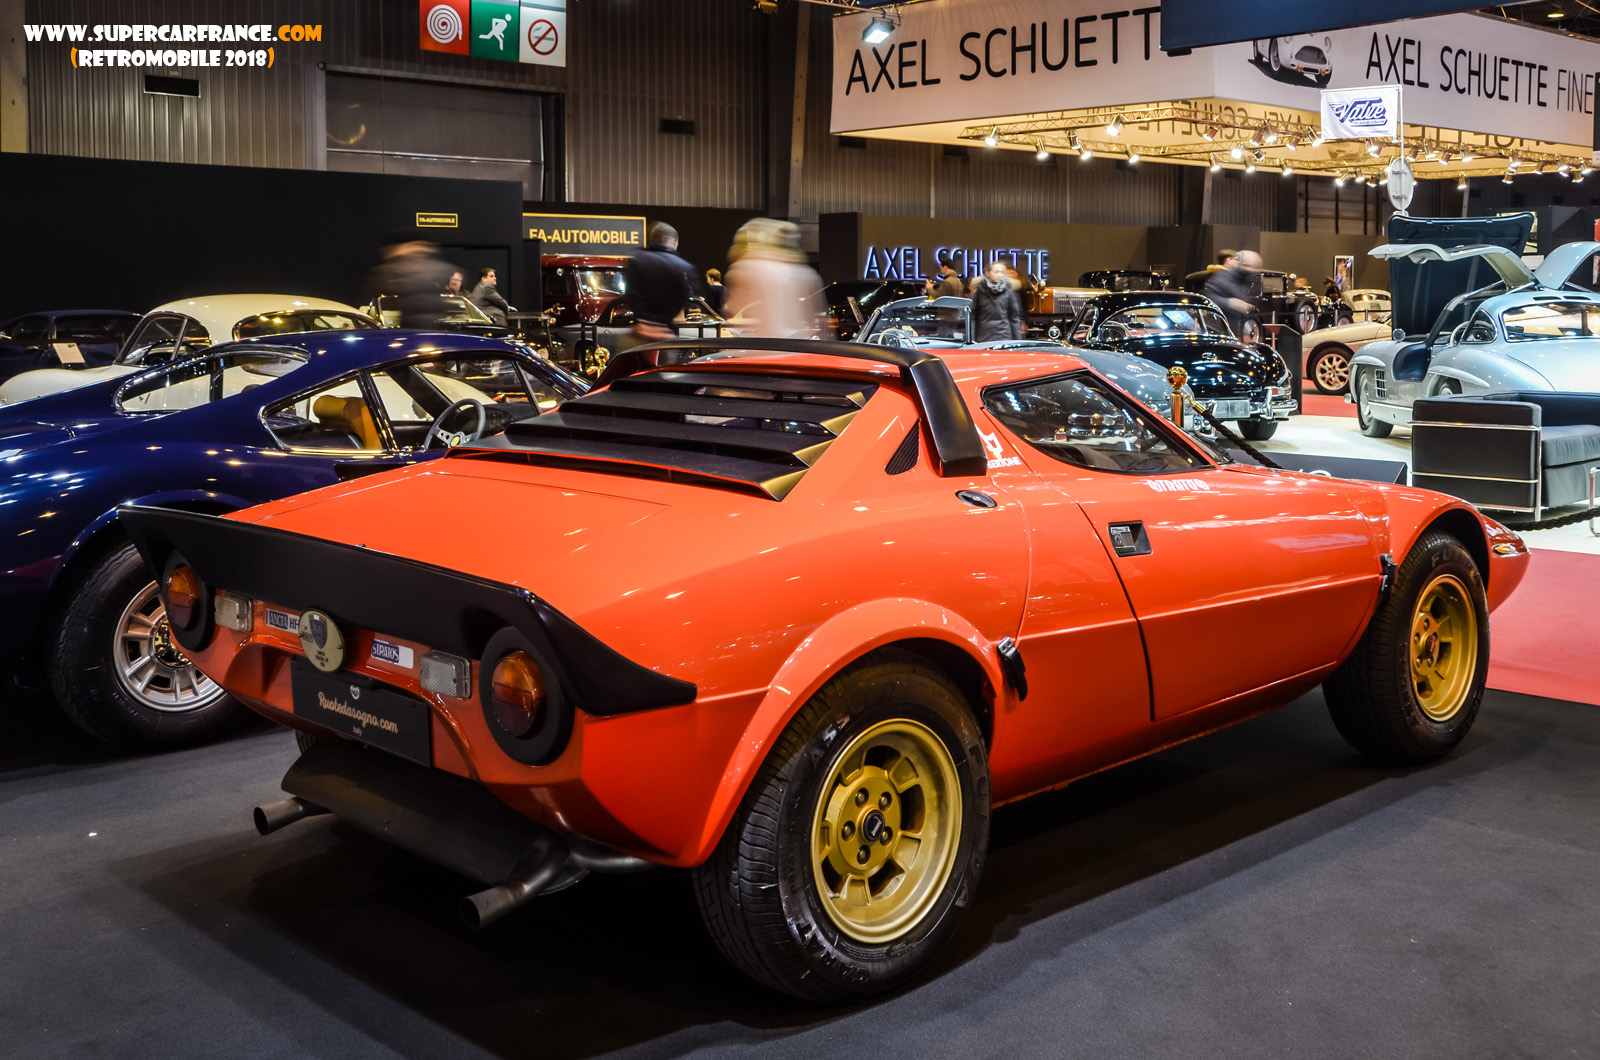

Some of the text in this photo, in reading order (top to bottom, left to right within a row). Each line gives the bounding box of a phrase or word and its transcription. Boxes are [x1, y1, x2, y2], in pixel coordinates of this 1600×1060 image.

[845, 5, 1193, 96] AXEL SCHUETT
[1366, 31, 1594, 115] AXEL SCHUETTE FINE
[1328, 97, 1387, 124] Valve
[529, 228, 640, 245] FA-AUTOMOBILE
[863, 245, 929, 280] AXEL
[987, 456, 1022, 469] BERTONE
[372, 643, 399, 661] STRATOS
